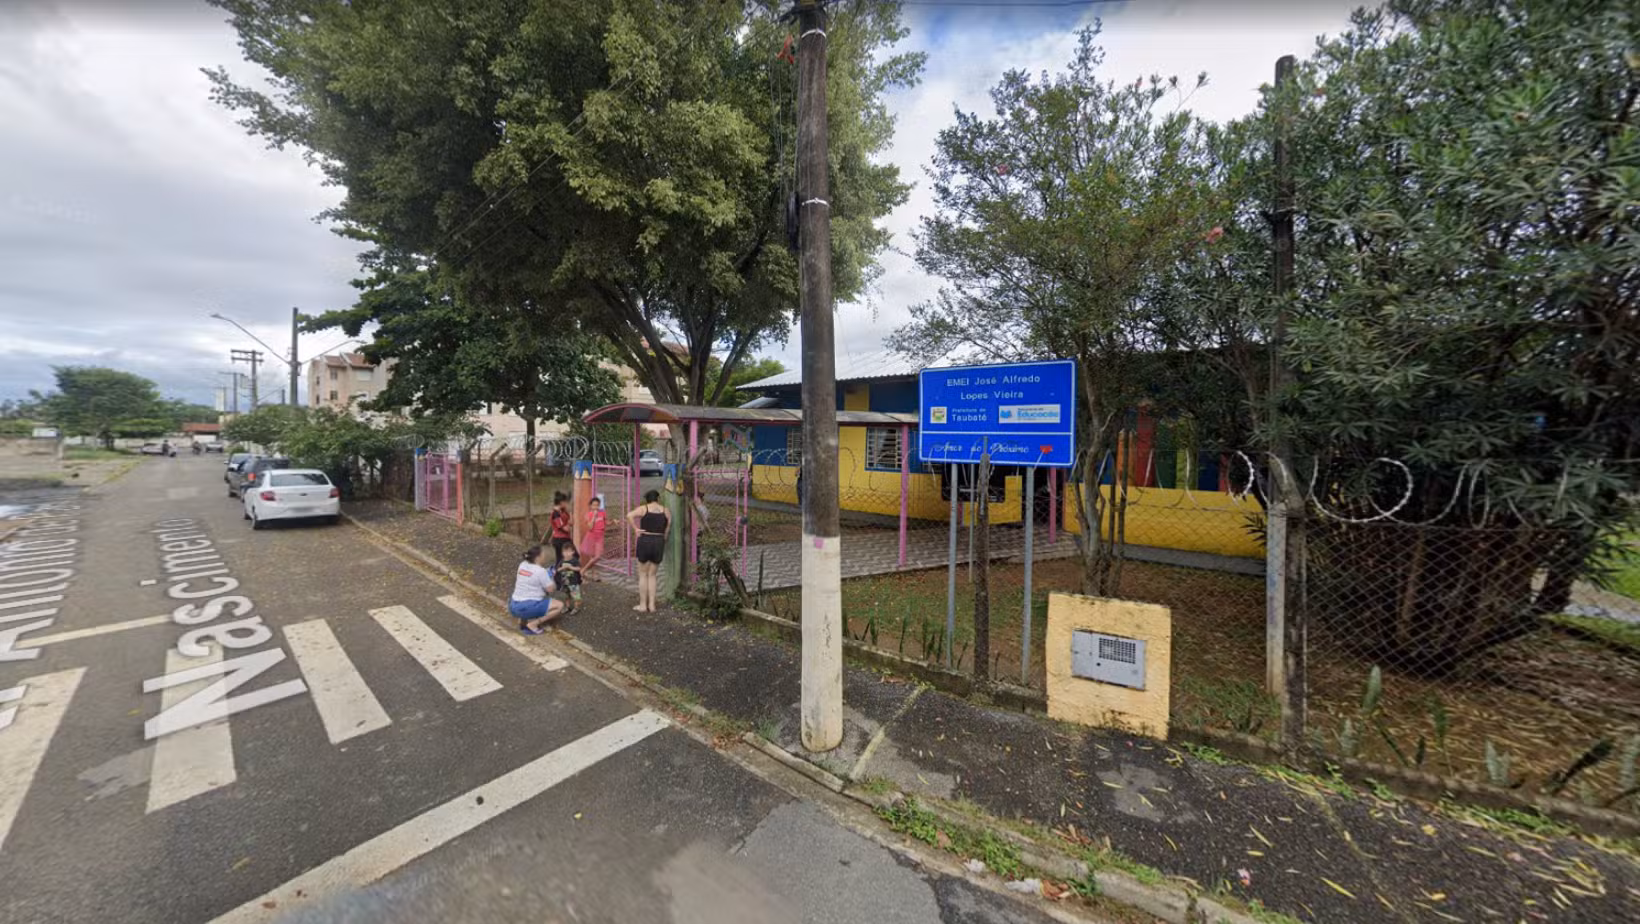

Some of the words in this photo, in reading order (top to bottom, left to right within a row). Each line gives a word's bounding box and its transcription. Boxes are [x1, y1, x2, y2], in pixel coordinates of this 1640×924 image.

[946, 377, 970, 387] EMEI
[974, 375, 997, 386] José
[1002, 374, 1041, 384] Alfredo
[960, 391, 988, 401] Lopes
[993, 390, 1024, 399] Vieira
[952, 414, 987, 422] Taubaté
